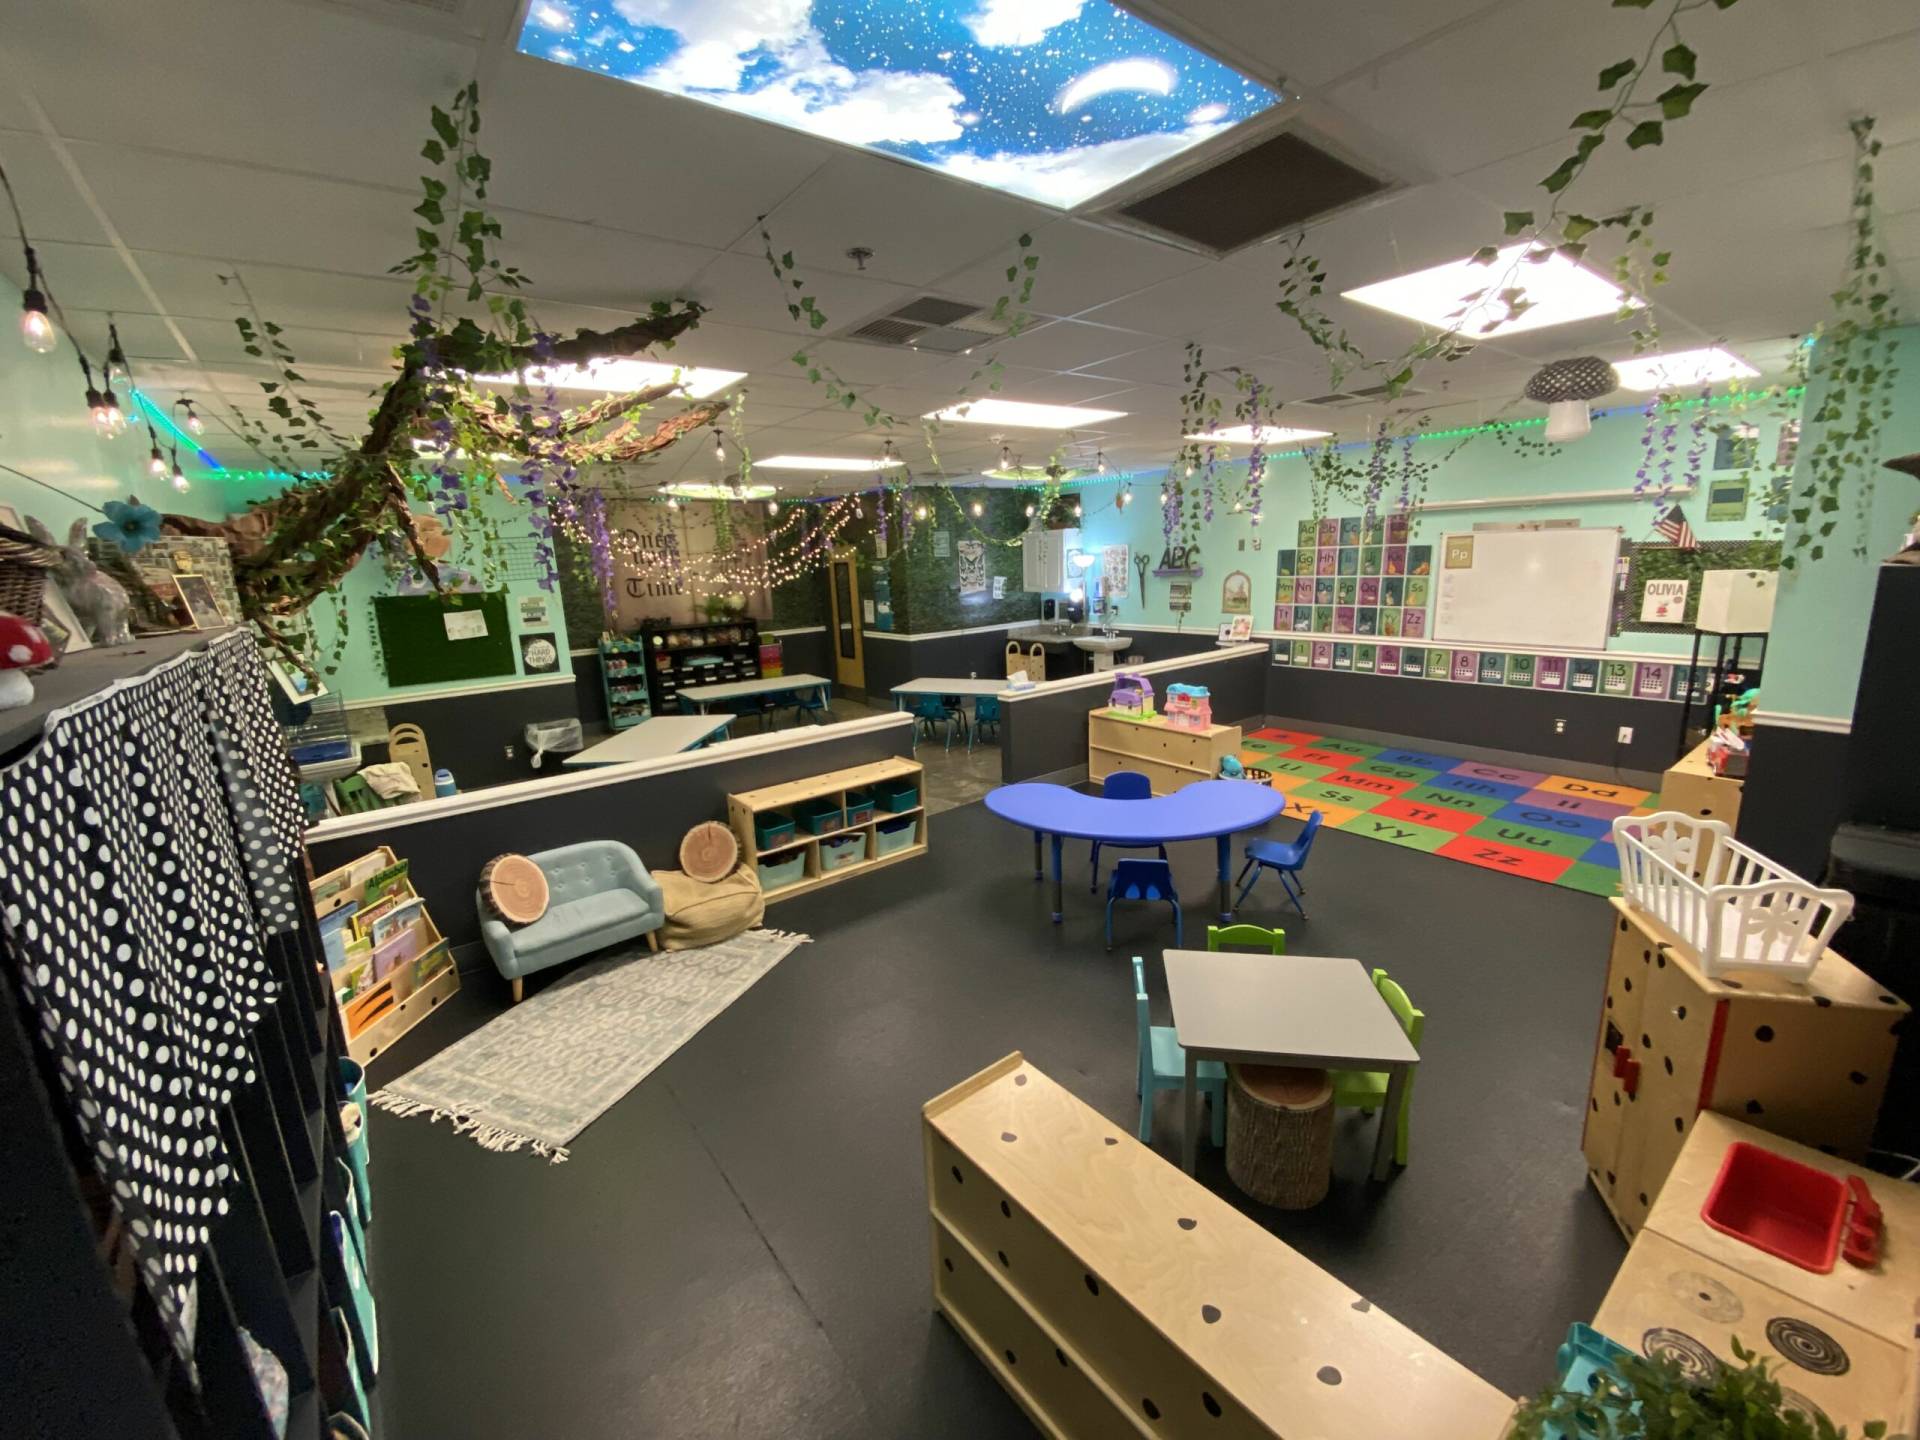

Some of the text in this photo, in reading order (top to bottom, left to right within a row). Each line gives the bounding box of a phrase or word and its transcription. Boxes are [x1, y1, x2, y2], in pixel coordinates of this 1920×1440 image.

[1159, 546, 1200, 570] ABC
[1299, 554, 1313, 566] Gg
[1319, 554, 1334, 563] Hh
[1451, 549, 1468, 560] Pp
[1297, 582, 1312, 592] Nn
[1340, 583, 1354, 595] Pp
[1411, 583, 1424, 592] Ss
[1647, 583, 1684, 596] OLIVIA
[1407, 613, 1422, 624] Zz
[1319, 645, 1327, 656] 2
[1435, 653, 1443, 665] 7
[1460, 655, 1469, 667] 8
[1487, 656, 1497, 669] 9
[1513, 657, 1530, 670] 10
[1609, 663, 1627, 677] 13
[1643, 666, 1662, 681] 14
[1473, 768, 1520, 780] Cc
[1336, 775, 1395, 791] Mm
[1452, 780, 1497, 793] Hh
[1320, 790, 1354, 802] Ss
[1562, 783, 1619, 797] Dd
[1425, 792, 1475, 808] Nn
[1408, 808, 1439, 820] Tt
[1520, 811, 1581, 828] Oo
[1373, 822, 1417, 838] Yy
[1497, 828, 1552, 847] Uu
[1473, 848, 1523, 866] Zz
